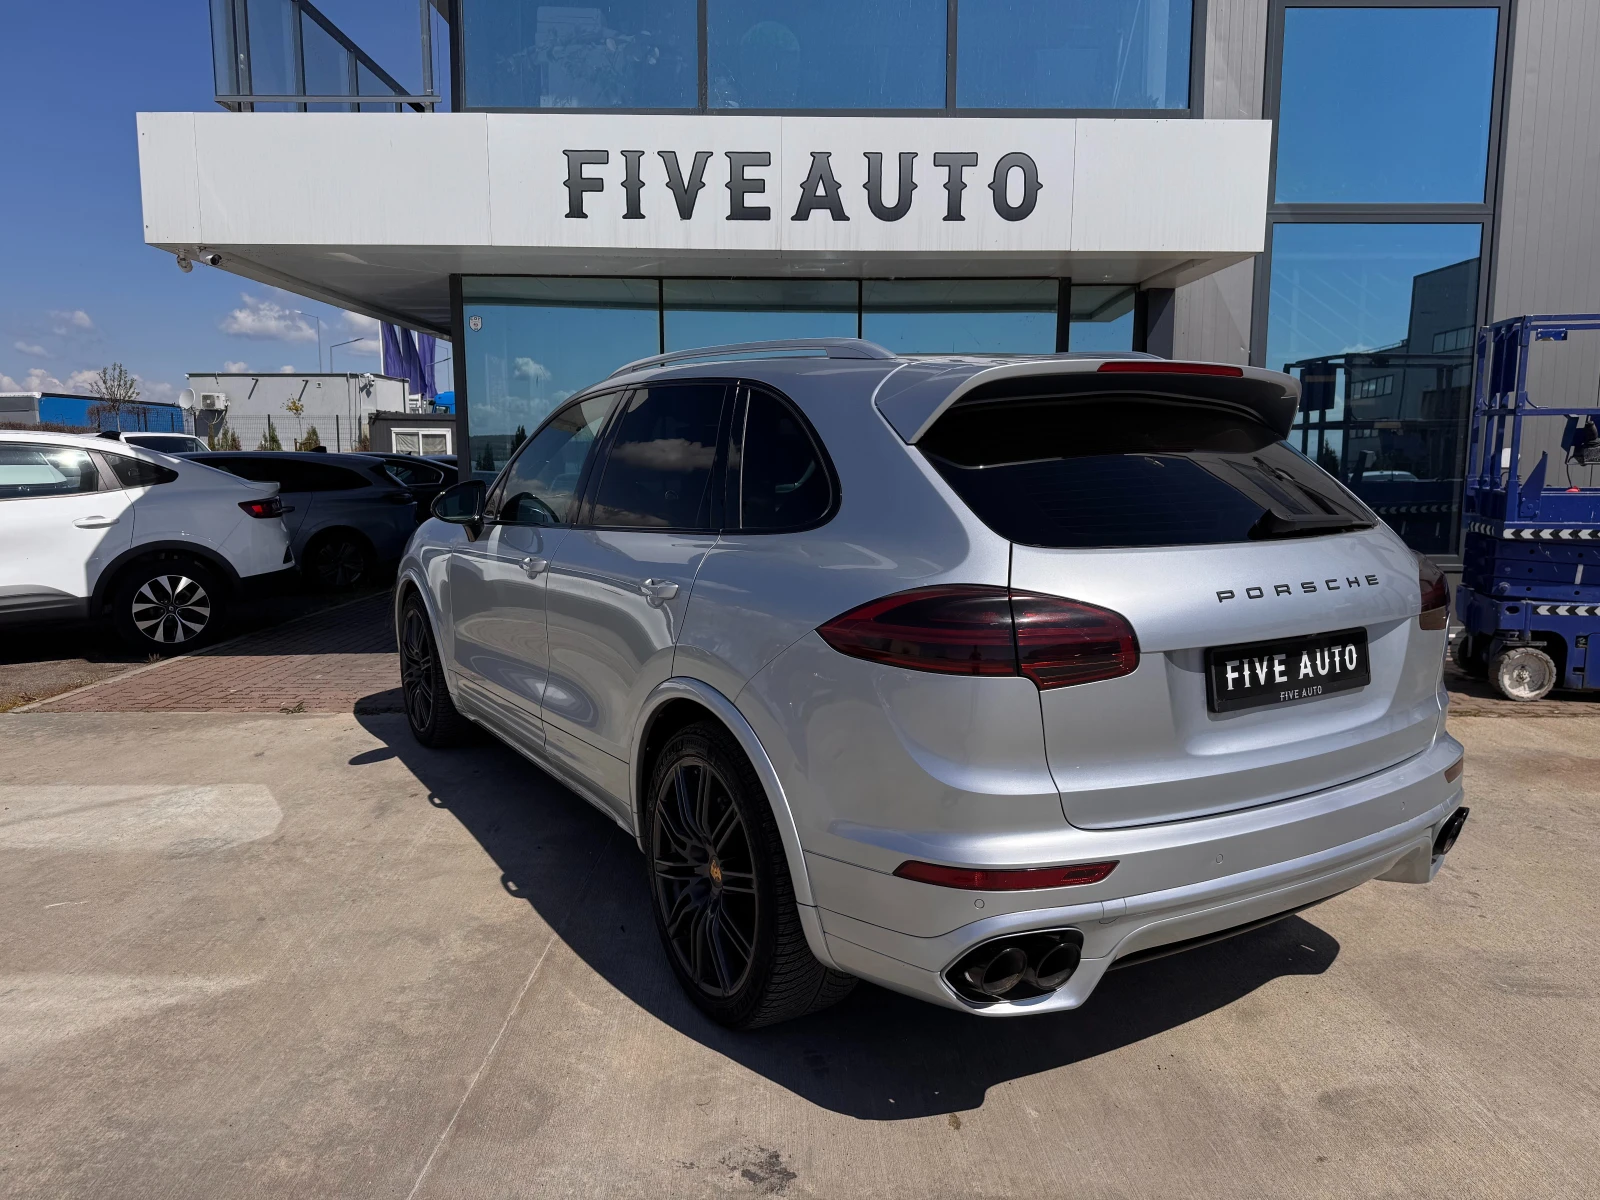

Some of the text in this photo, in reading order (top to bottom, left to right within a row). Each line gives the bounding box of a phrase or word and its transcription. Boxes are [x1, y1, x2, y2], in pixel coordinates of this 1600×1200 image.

[1216, 574, 1379, 603] PORSCHE
[1226, 643, 1357, 690] FIVE AUTO
[1280, 686, 1322, 701] FIVE AUTO
